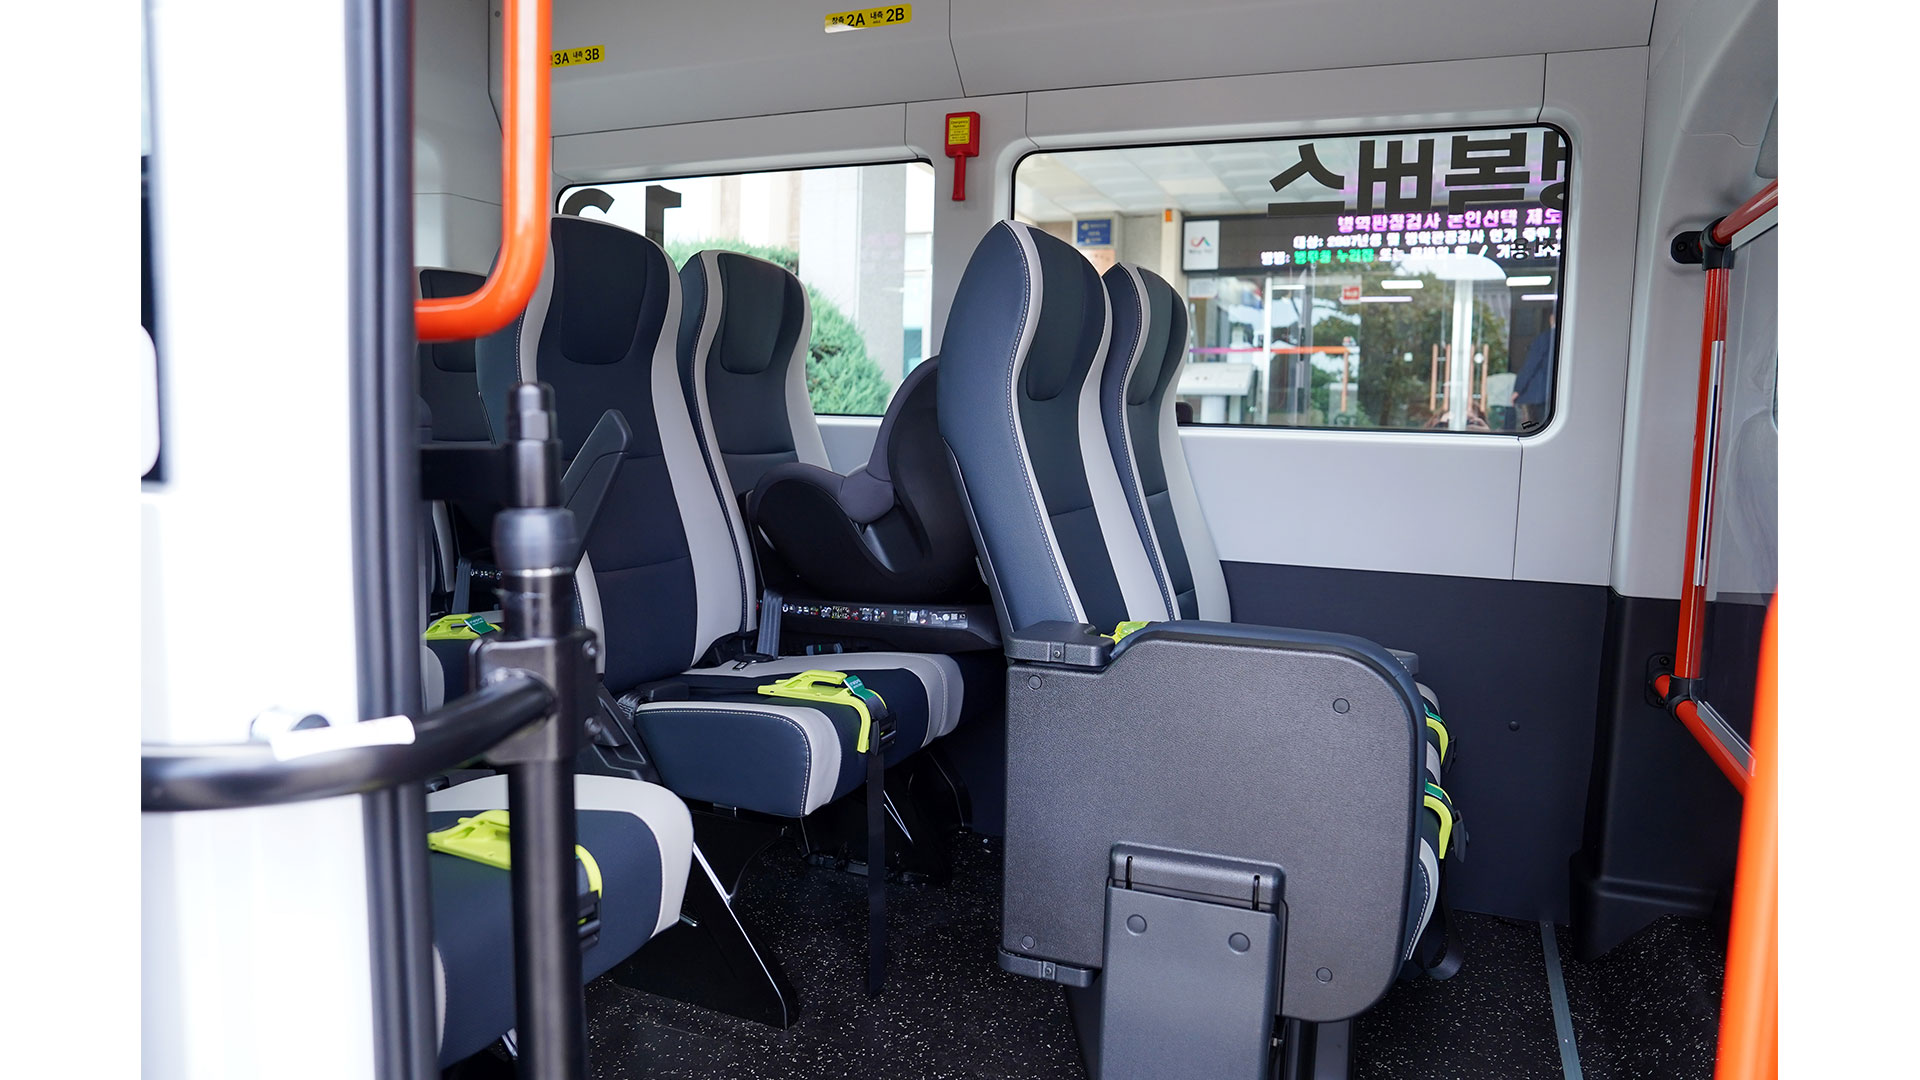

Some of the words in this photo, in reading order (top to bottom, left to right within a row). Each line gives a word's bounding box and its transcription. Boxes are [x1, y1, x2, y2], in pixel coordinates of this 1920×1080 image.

[846, 12, 866, 27] 2A
[870, 11, 884, 20] 내측
[886, 7, 905, 22] 2B
[554, 52, 570, 66] 3A
[572, 50, 583, 59] 내측
[585, 48, 600, 61] 3B
[1337, 211, 1442, 234] 병역판정검사
[1447, 208, 1518, 230] 본인선택
[1526, 207, 1563, 226] 제도
